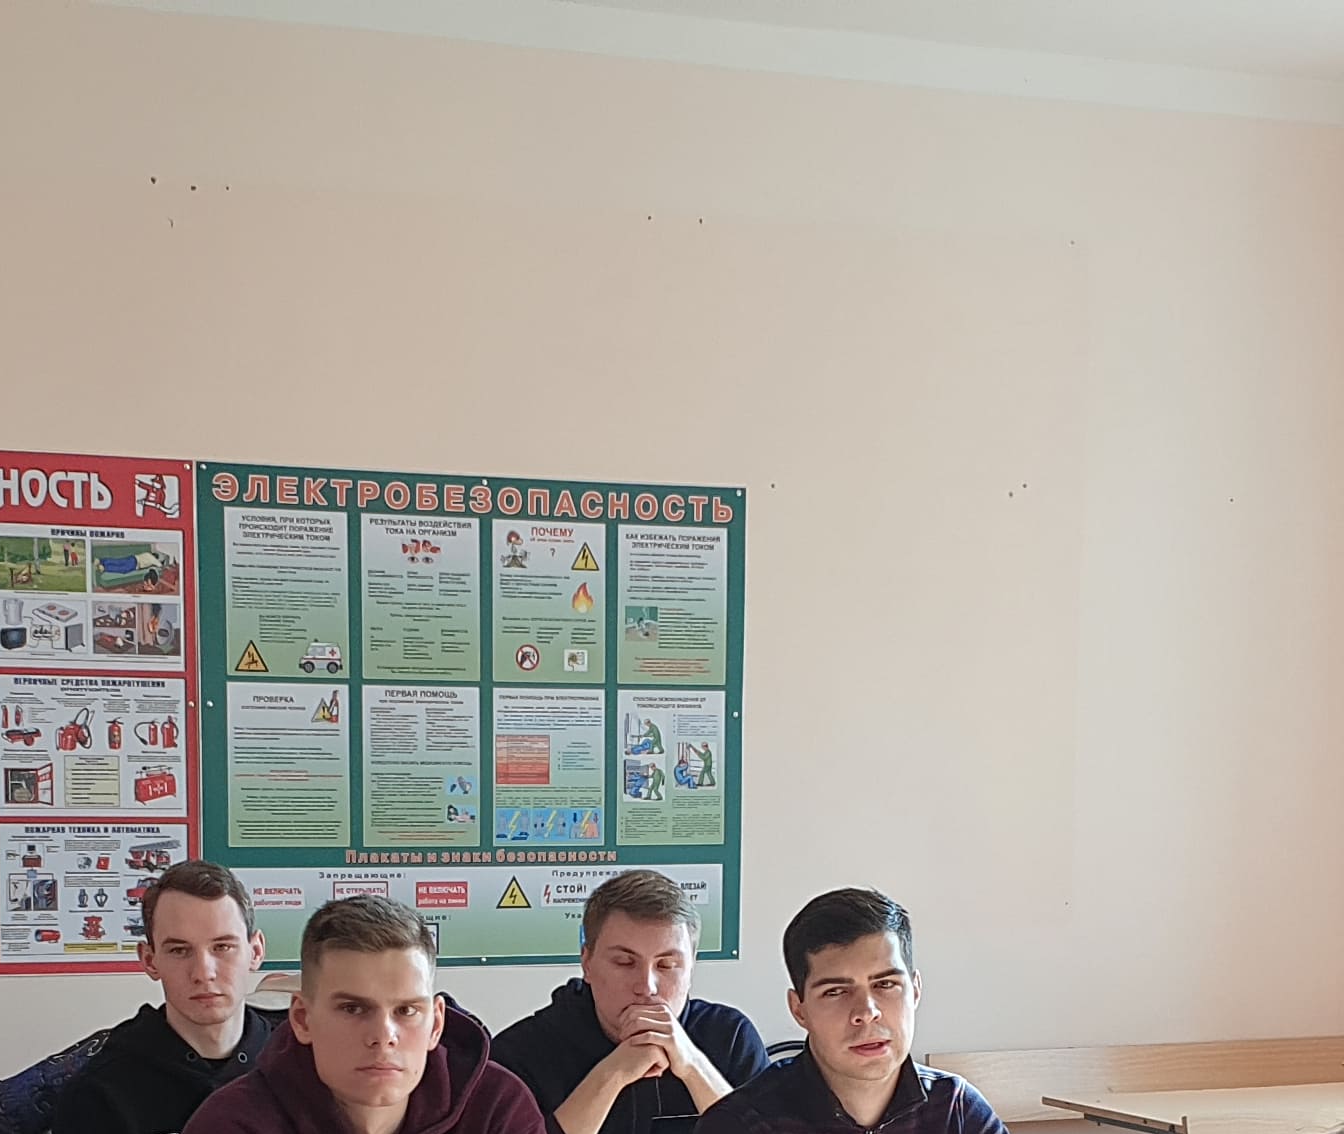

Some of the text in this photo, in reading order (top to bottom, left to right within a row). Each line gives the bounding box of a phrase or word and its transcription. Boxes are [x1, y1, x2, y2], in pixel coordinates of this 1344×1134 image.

[212, 472, 733, 523] ЭЛЕКТРОБЕЗОПАСНОСТЬ
[531, 527, 574, 538] ПОЧЕМУ
[253, 695, 295, 704] ПРОВЕРКА
[385, 689, 458, 699] ПЕРВАЯ ПОМОЩЬ
[346, 848, 617, 864] Плакаты и знаки безопасности
[551, 870, 624, 878] Предупрежд
[556, 883, 587, 894] СТОЙ!
